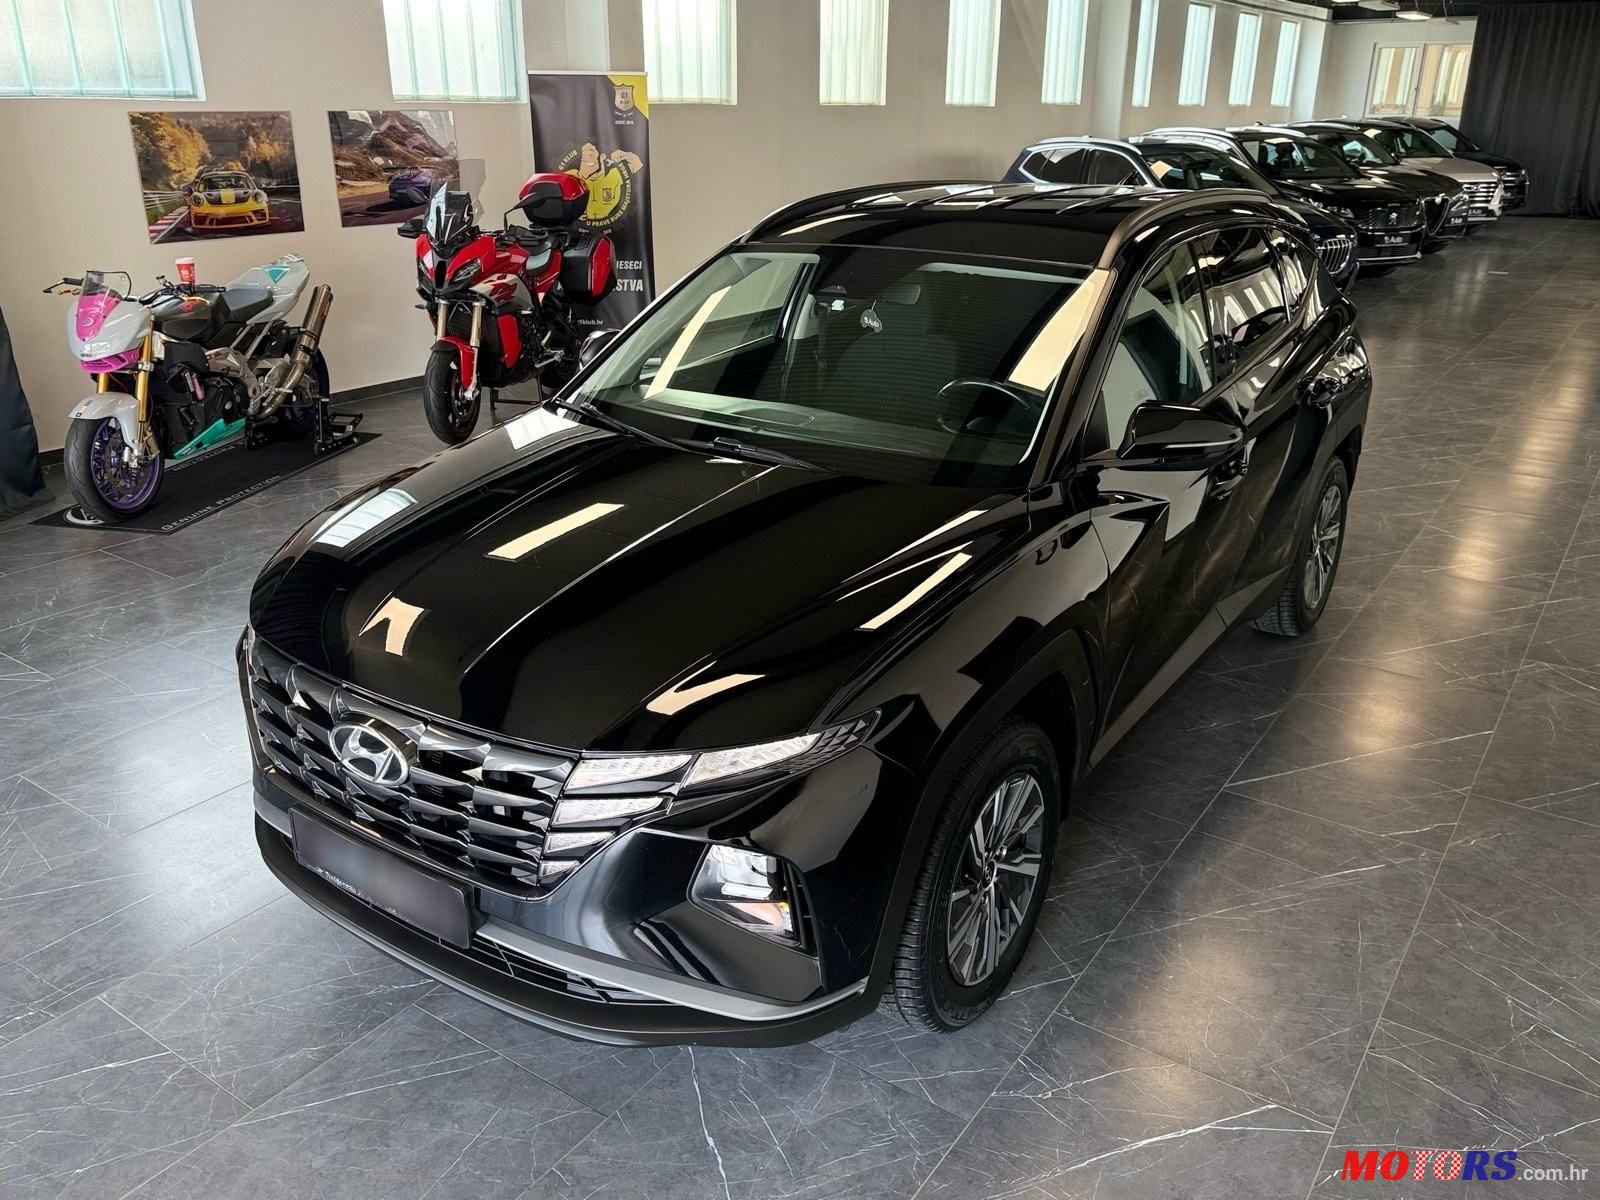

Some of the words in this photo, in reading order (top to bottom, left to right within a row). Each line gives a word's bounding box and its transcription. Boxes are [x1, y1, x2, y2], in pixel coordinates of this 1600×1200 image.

[563, 149, 578, 162] KLUB
[591, 219, 611, 227] PRAVE
[610, 208, 624, 223] RUKE
[620, 179, 632, 211] MAJSTORA
[612, 279, 644, 291] STVA
[161, 505, 216, 531] GENUINE
[216, 475, 281, 505] PROTECTION
